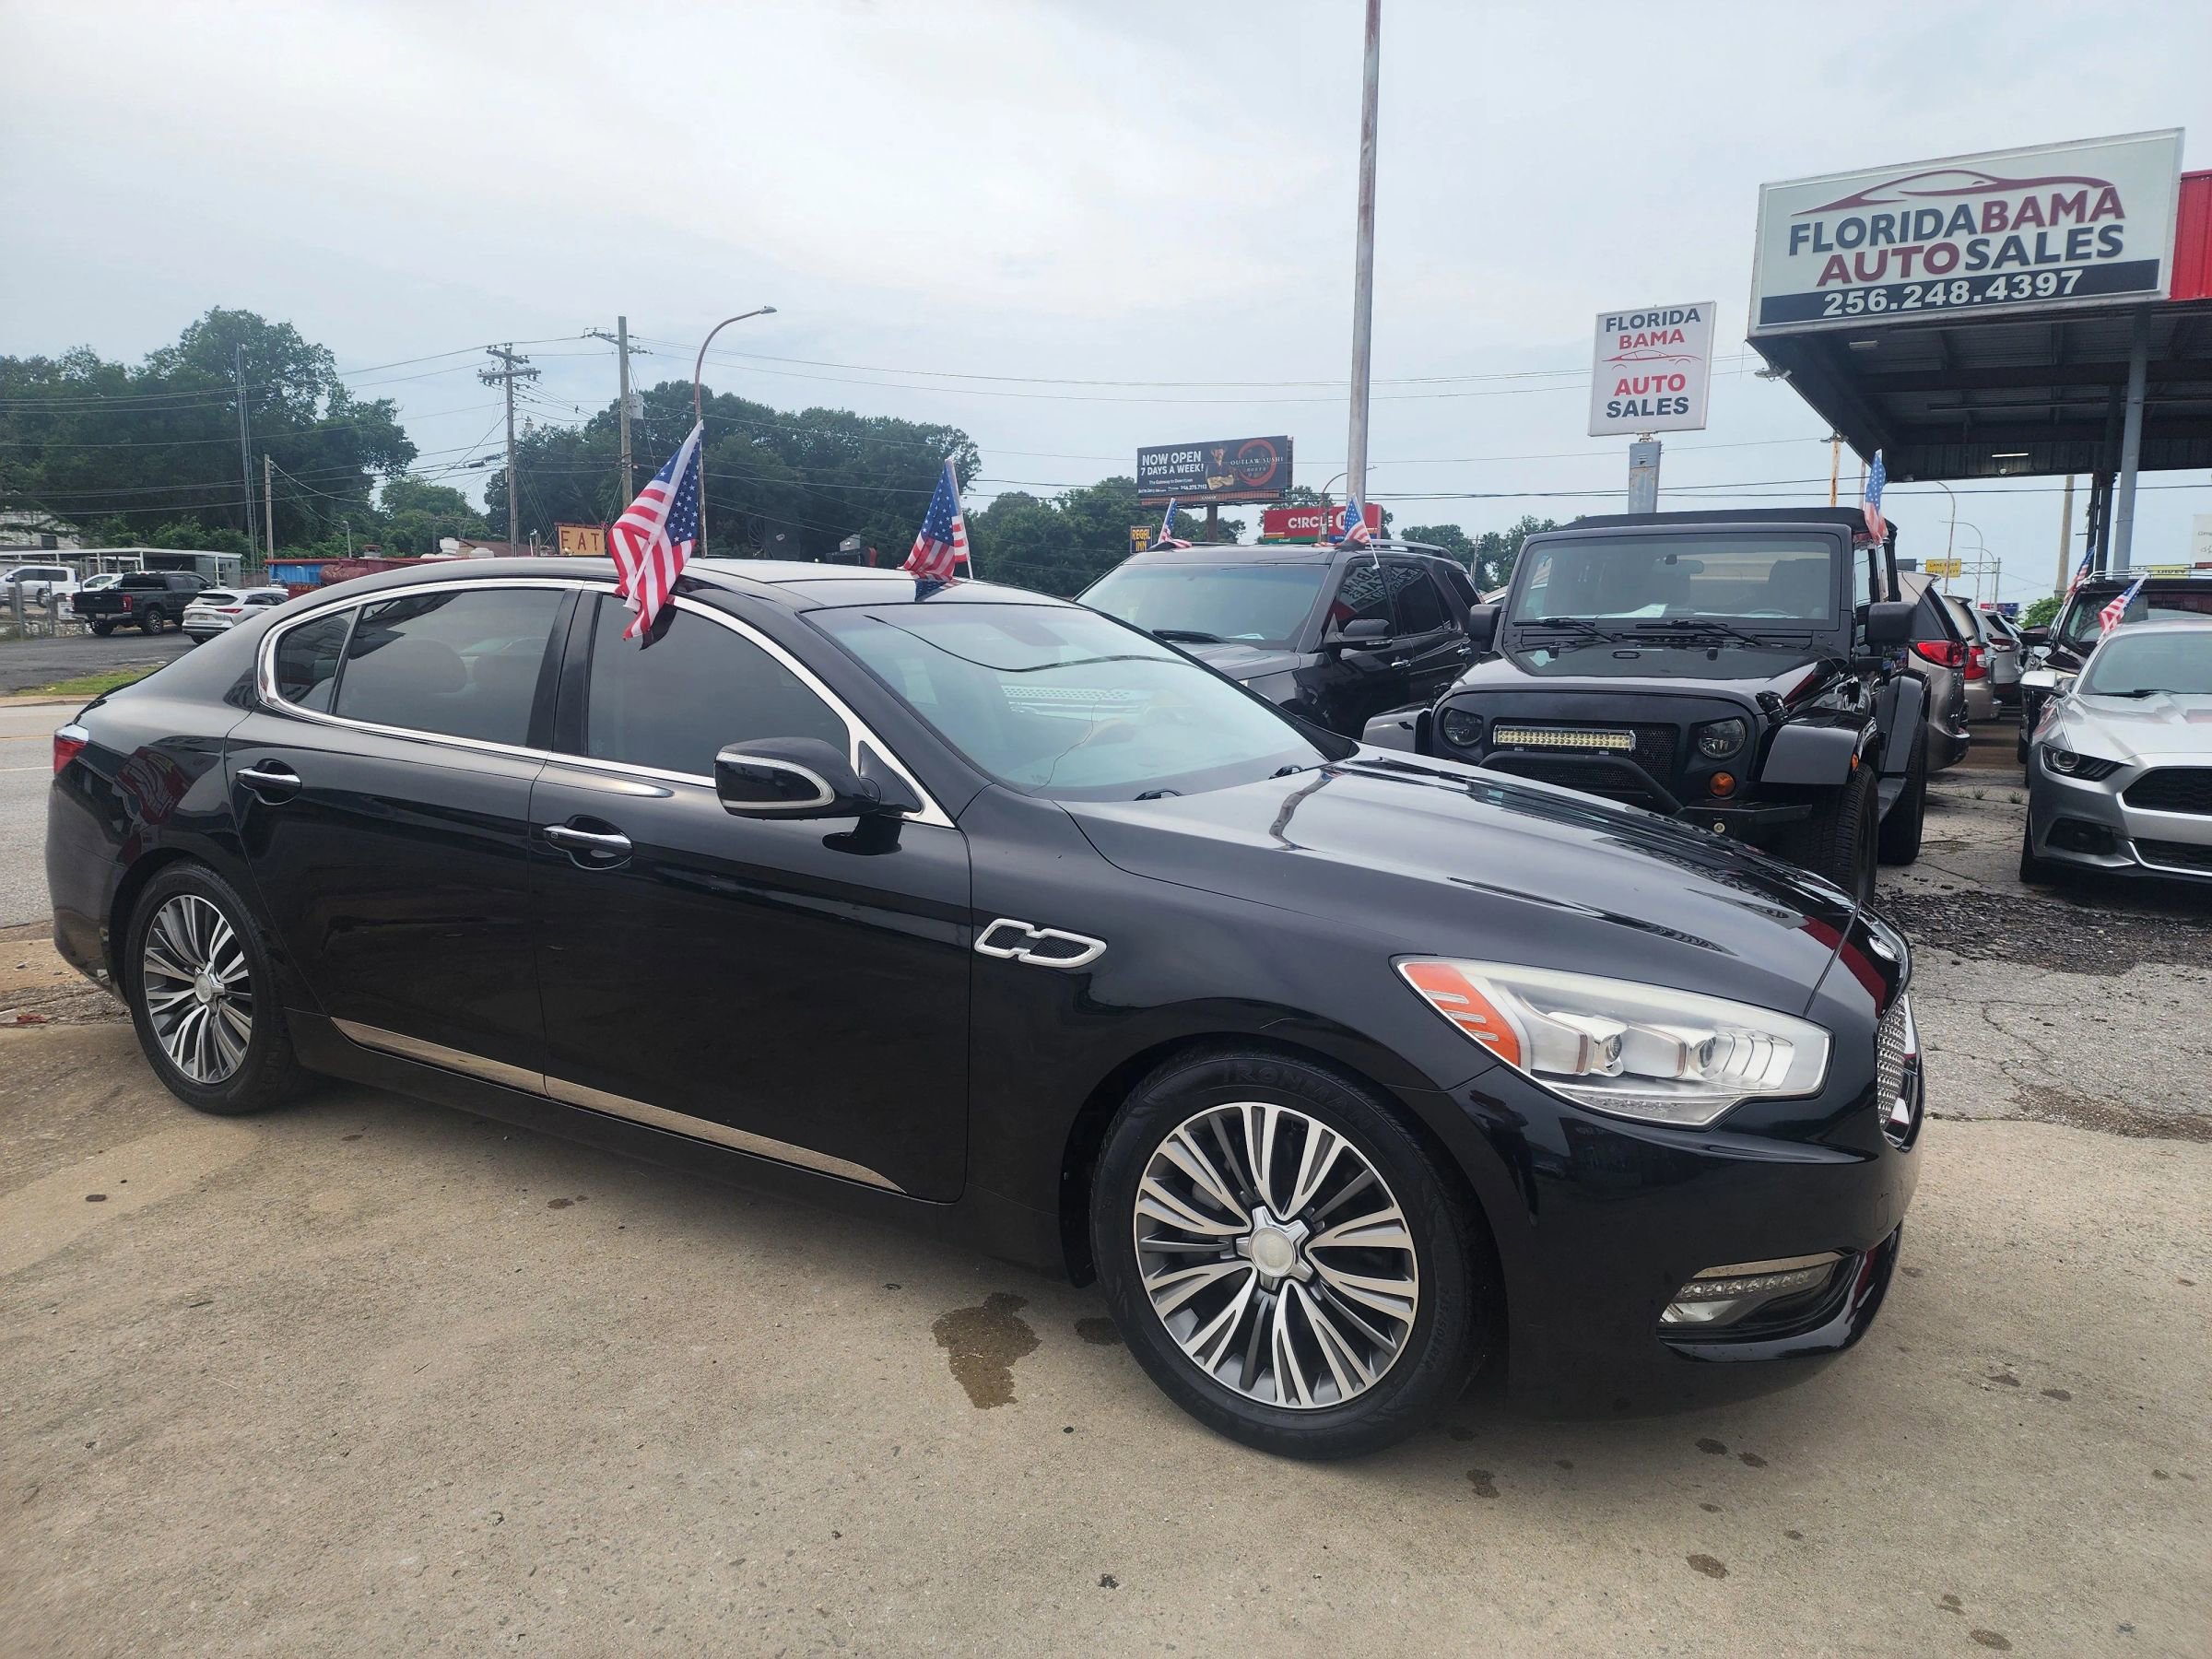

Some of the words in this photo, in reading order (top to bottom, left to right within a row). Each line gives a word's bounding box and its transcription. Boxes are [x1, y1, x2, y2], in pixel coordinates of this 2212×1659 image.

[1822, 269, 2083, 316] 256.248.4397
[1606, 308, 1701, 332] FLORIDA
[1618, 328, 1685, 349] BAMA
[1614, 373, 1686, 396] AUTO
[1606, 396, 1689, 418] SALES
[1142, 453, 1169, 466] NOW
[1171, 450, 1202, 465] OPEN
[1140, 467, 1146, 476] 7
[1147, 465, 1168, 476] DAYS
[1169, 465, 1175, 474] A
[1176, 464, 1204, 474] WEEK!
[1288, 515, 1334, 529] CIRCLE
[560, 530, 600, 551] EAT
[1132, 528, 1151, 540] REGAL
[1135, 540, 1147, 552] INN
